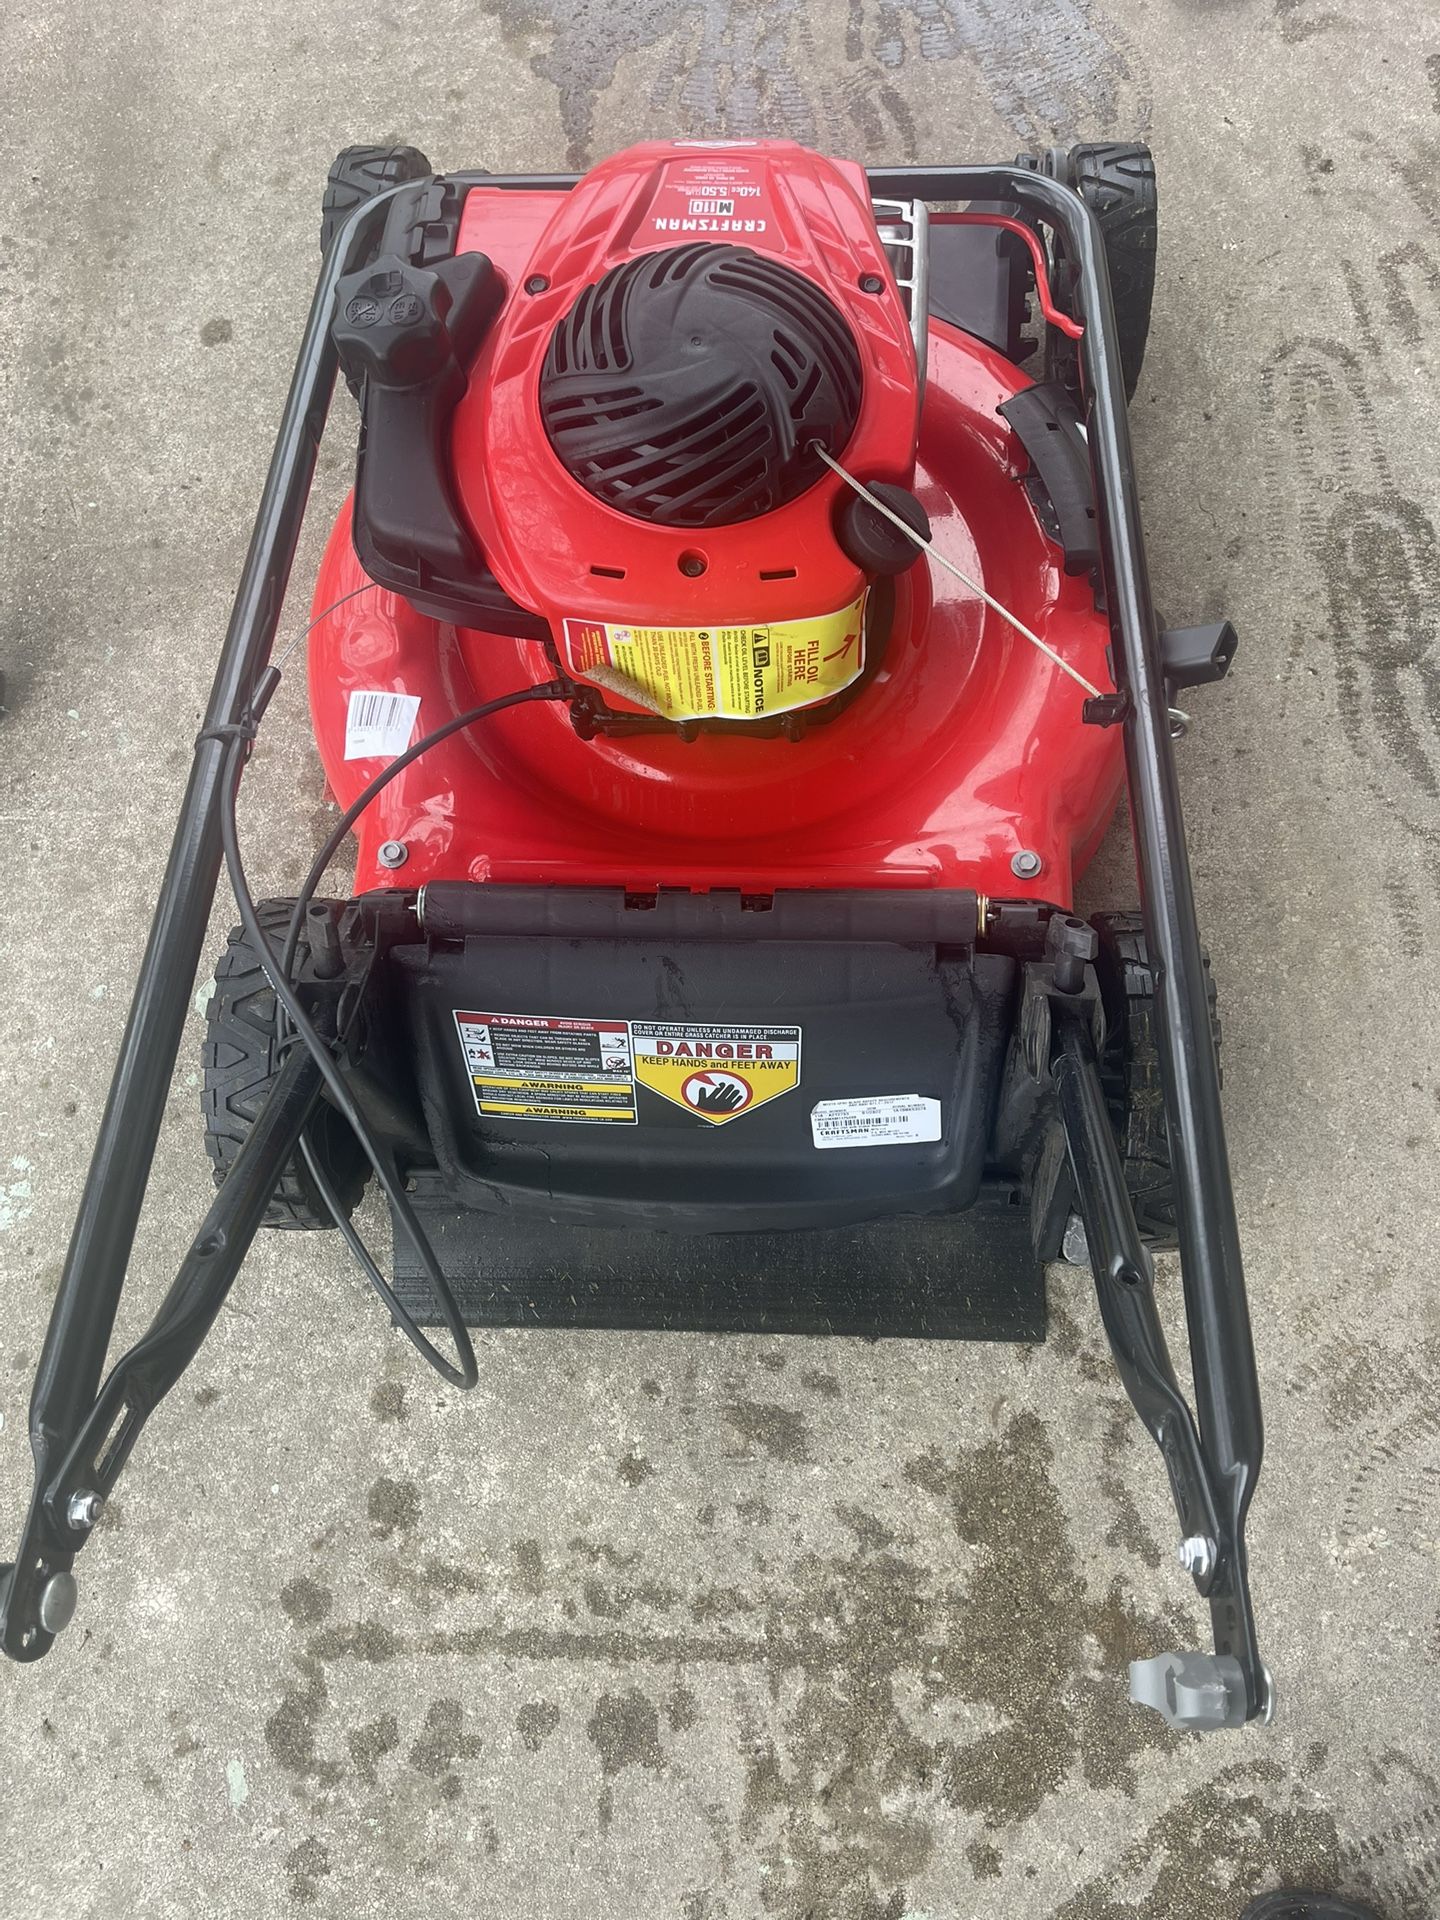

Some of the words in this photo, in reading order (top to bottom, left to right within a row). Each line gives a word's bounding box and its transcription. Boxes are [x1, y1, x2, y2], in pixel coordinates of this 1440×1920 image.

[702, 186, 728, 196] 5.50
[731, 186, 761, 196] 140cc
[691, 201, 732, 213] M110
[656, 218, 766, 231] CRAFTSMAN
[701, 641, 712, 671] BEFORE
[808, 640, 819, 665] FILL
[794, 650, 805, 680] HERE
[807, 666, 818, 684] OIL
[704, 673, 715, 710] STARTING:
[754, 669, 764, 713] NOTICE
[501, 1018, 548, 1026] DANGER
[656, 1041, 772, 1058] DANGER
[642, 1057, 669, 1065] KEEP
[672, 1059, 707, 1067] HANDS
[710, 1060, 728, 1069] and
[534, 1108, 586, 1116] WARNING
